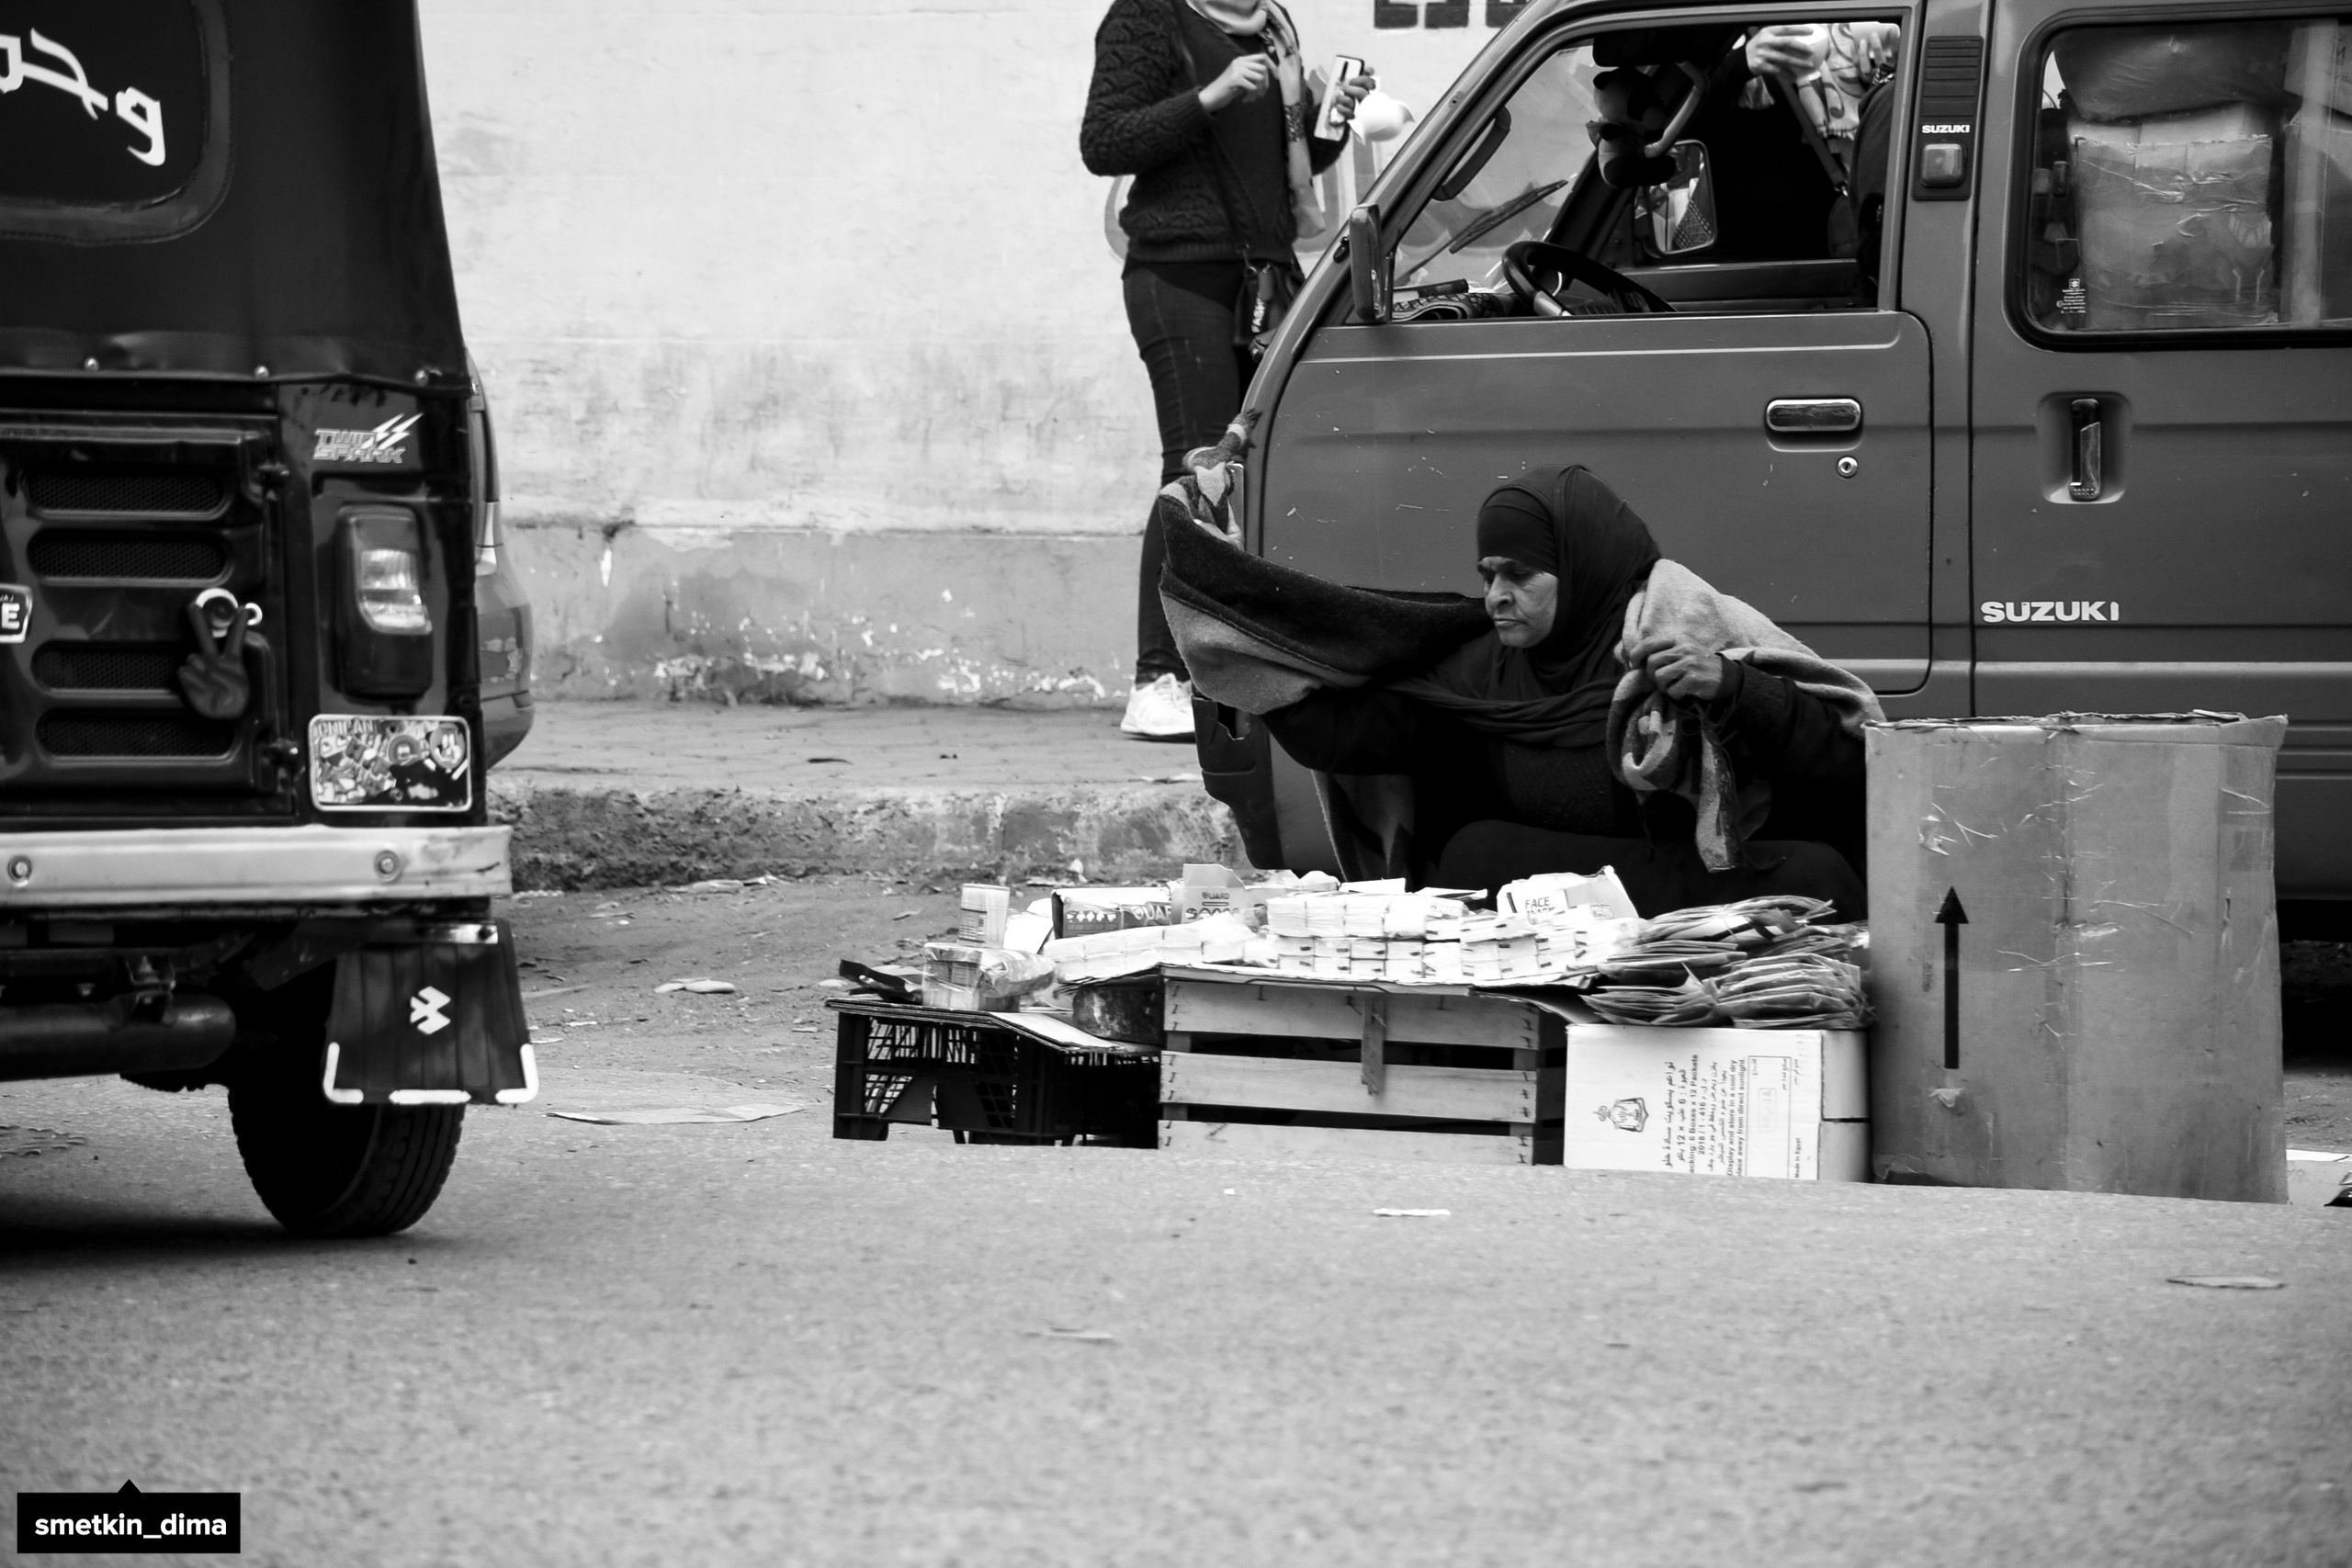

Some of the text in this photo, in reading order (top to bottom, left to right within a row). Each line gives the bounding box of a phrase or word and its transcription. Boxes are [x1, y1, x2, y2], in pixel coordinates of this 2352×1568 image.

[1922, 124, 1970, 133] SUZUKI
[312, 446, 406, 464] SPARK
[1980, 601, 2120, 623] SUZUKI
[1524, 897, 1550, 909] FACE
[1728, 1060, 1737, 1072] dry
[1690, 1089, 1697, 1098] 12
[1736, 1092, 1745, 1114] direct
[1677, 1135, 1686, 1145] 12
[1726, 1147, 1736, 1176] Display
